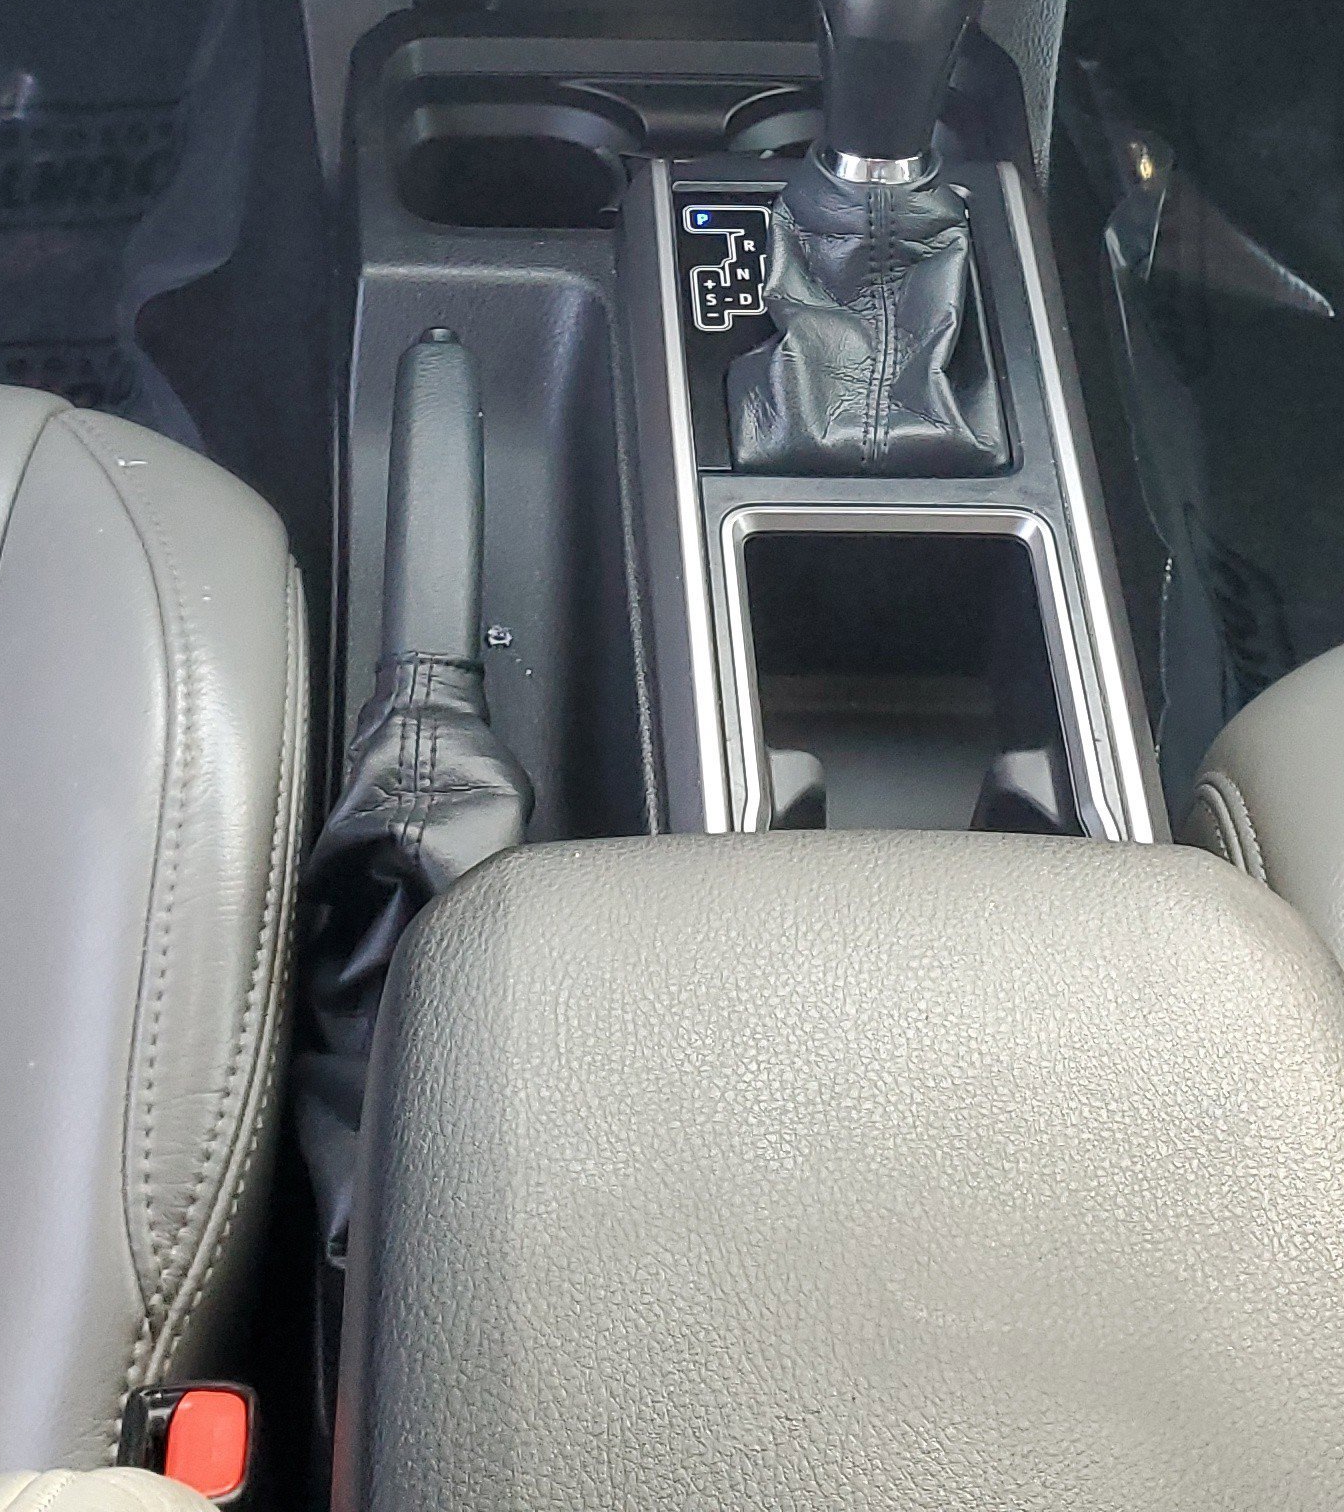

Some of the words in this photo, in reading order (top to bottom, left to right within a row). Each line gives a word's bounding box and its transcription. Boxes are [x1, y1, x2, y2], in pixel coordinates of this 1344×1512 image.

[696, 213, 709, 226] P
[743, 239, 756, 252] R
[736, 268, 751, 281] N
[705, 293, 717, 306] S
[739, 293, 753, 305] D
